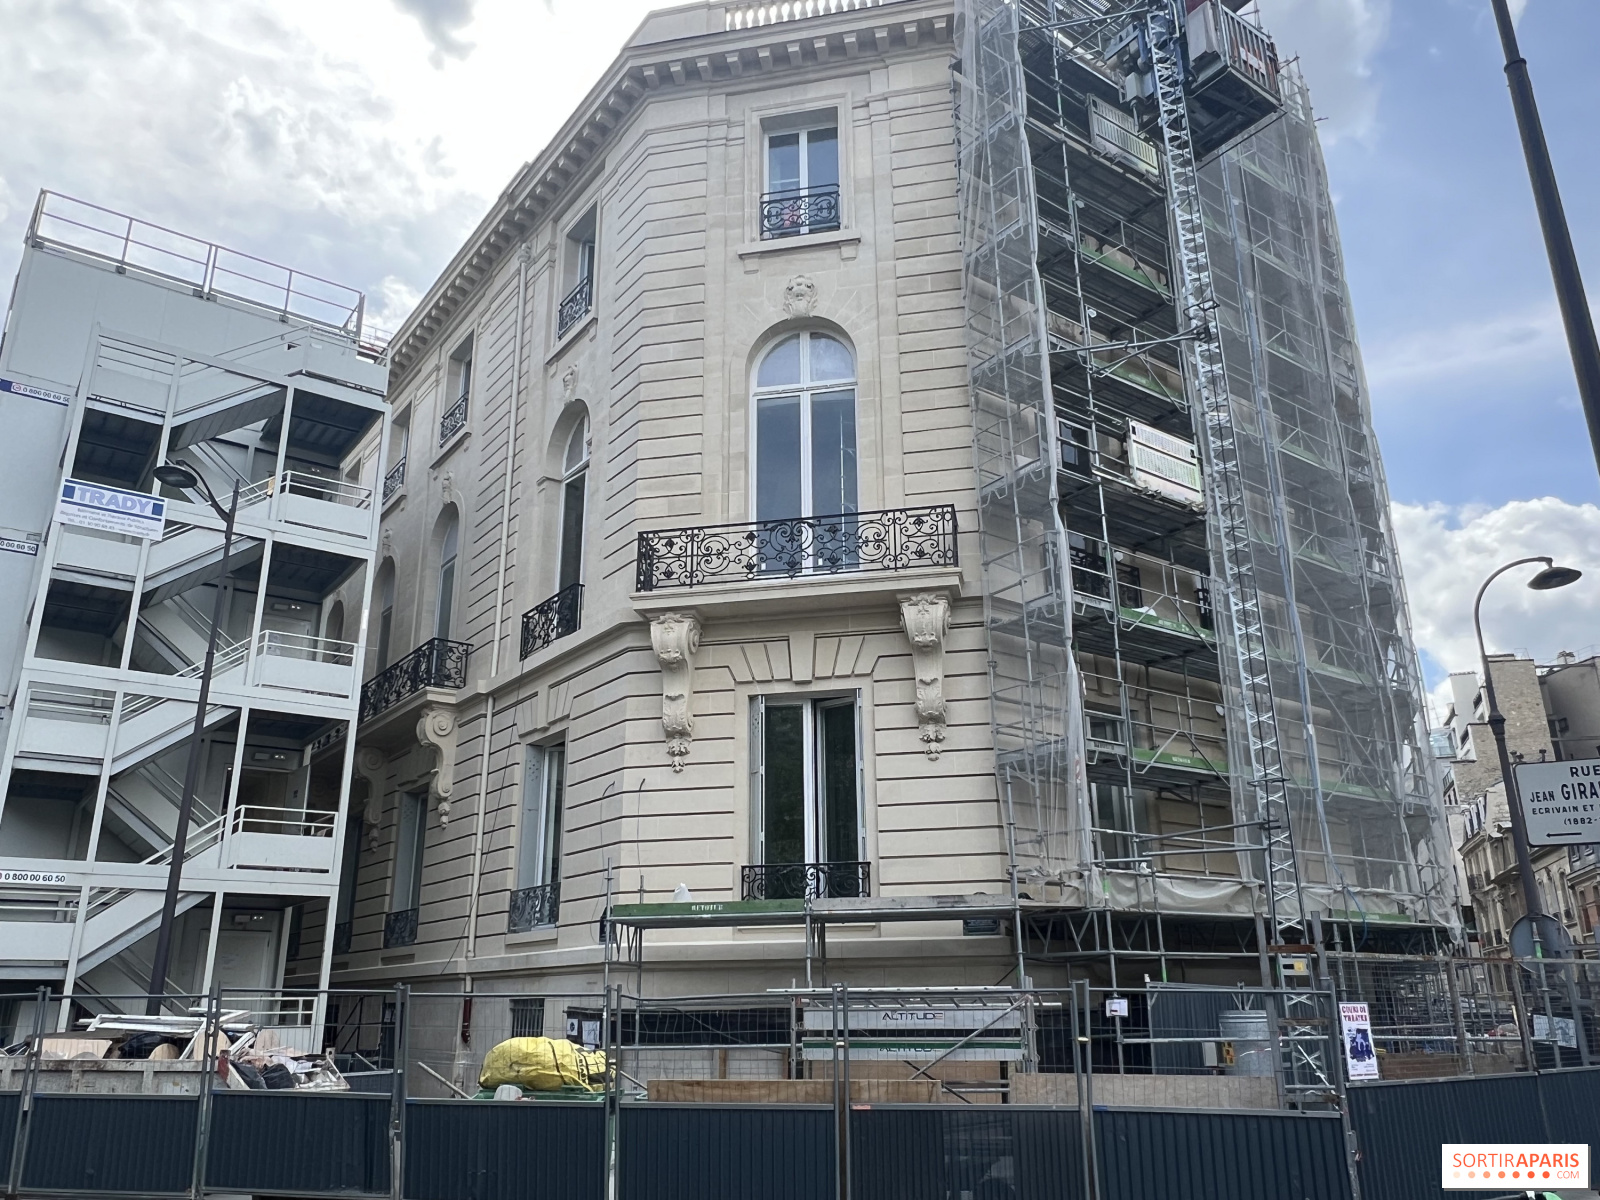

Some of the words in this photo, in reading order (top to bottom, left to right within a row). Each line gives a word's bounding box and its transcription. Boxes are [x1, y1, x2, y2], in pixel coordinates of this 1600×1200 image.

[78, 487, 152, 513] TRADY
[1570, 765, 1600, 777] RUE
[1530, 791, 1555, 802] JEAN
[1561, 782, 1600, 800] GIRA
[1532, 806, 1579, 815] ECRIVAIN
[1583, 804, 1594, 812] ET
[12, 873, 28, 881] 800
[30, 874, 40, 882] 00
[882, 1012, 944, 1021] ALTITUDE
